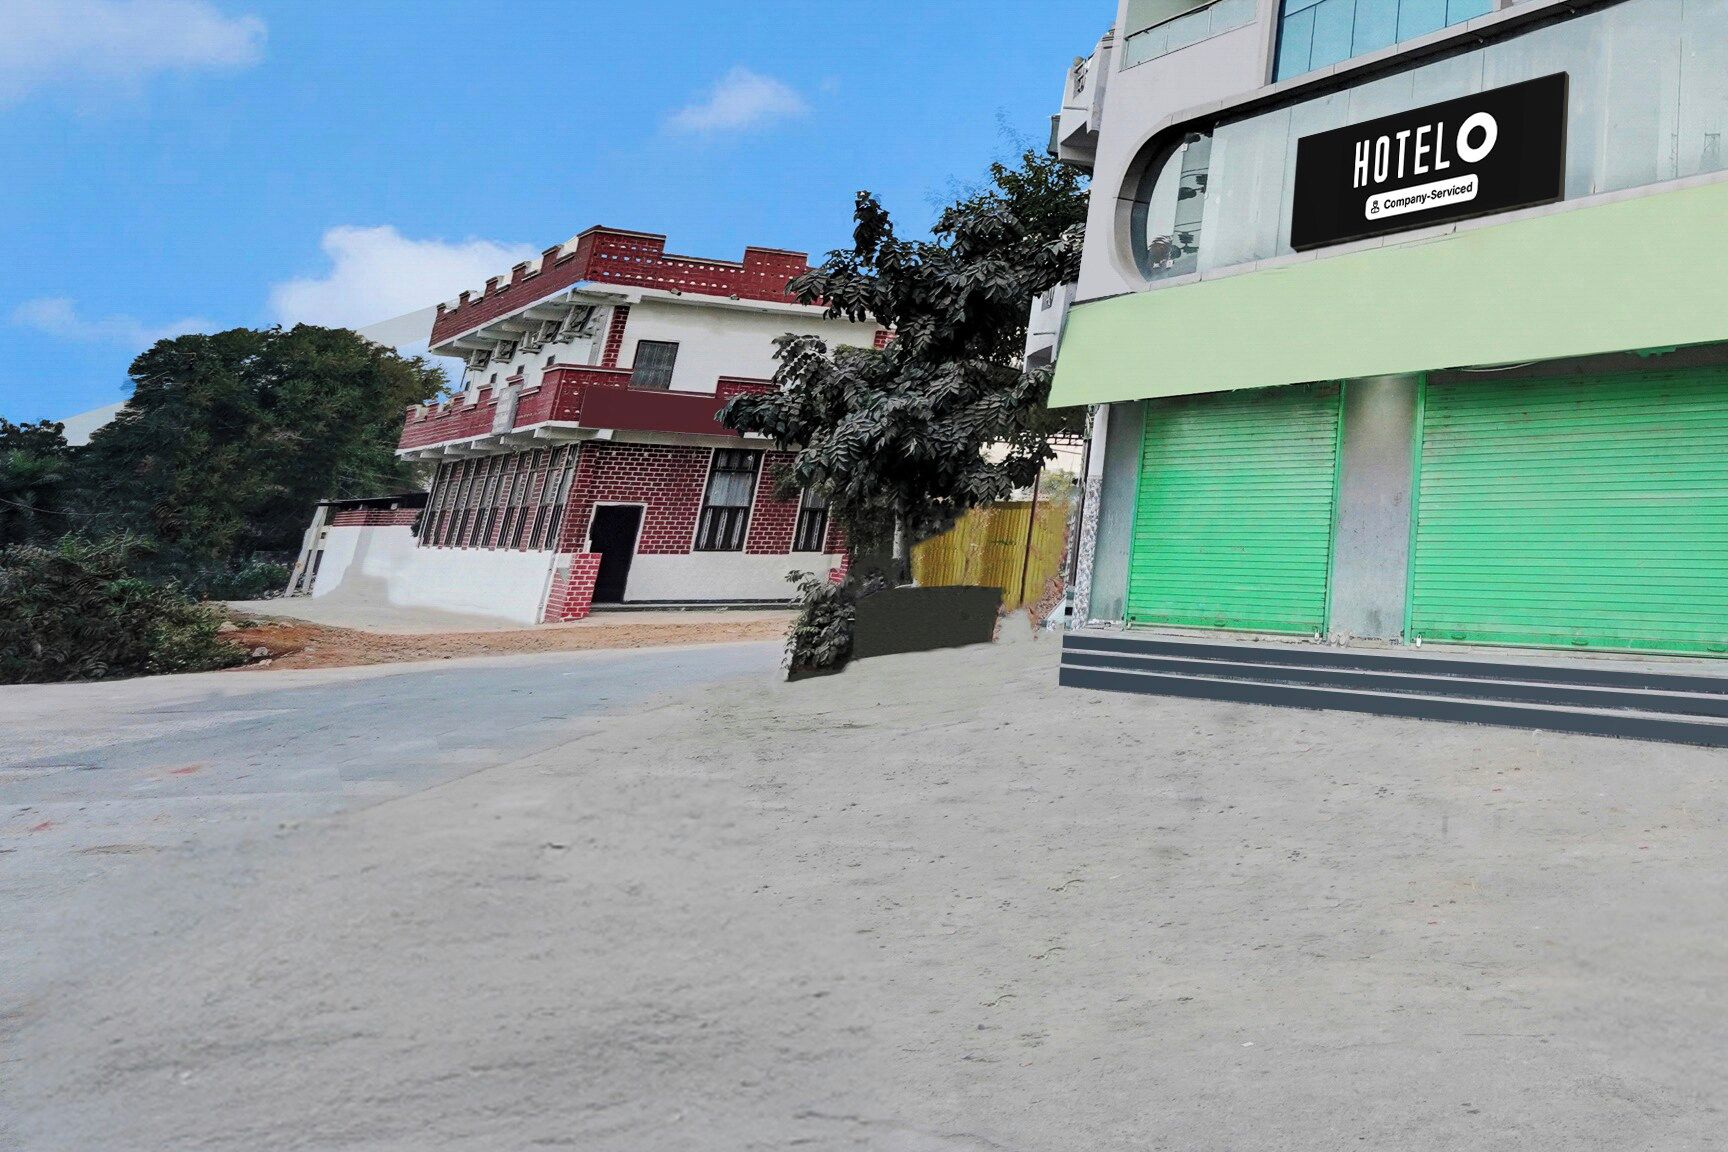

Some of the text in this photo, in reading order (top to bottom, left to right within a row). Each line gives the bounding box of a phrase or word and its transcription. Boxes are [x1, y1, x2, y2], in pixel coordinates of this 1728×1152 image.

[1353, 111, 1498, 188] HOTEL O
[1383, 182, 1473, 209] Company-Serviced
